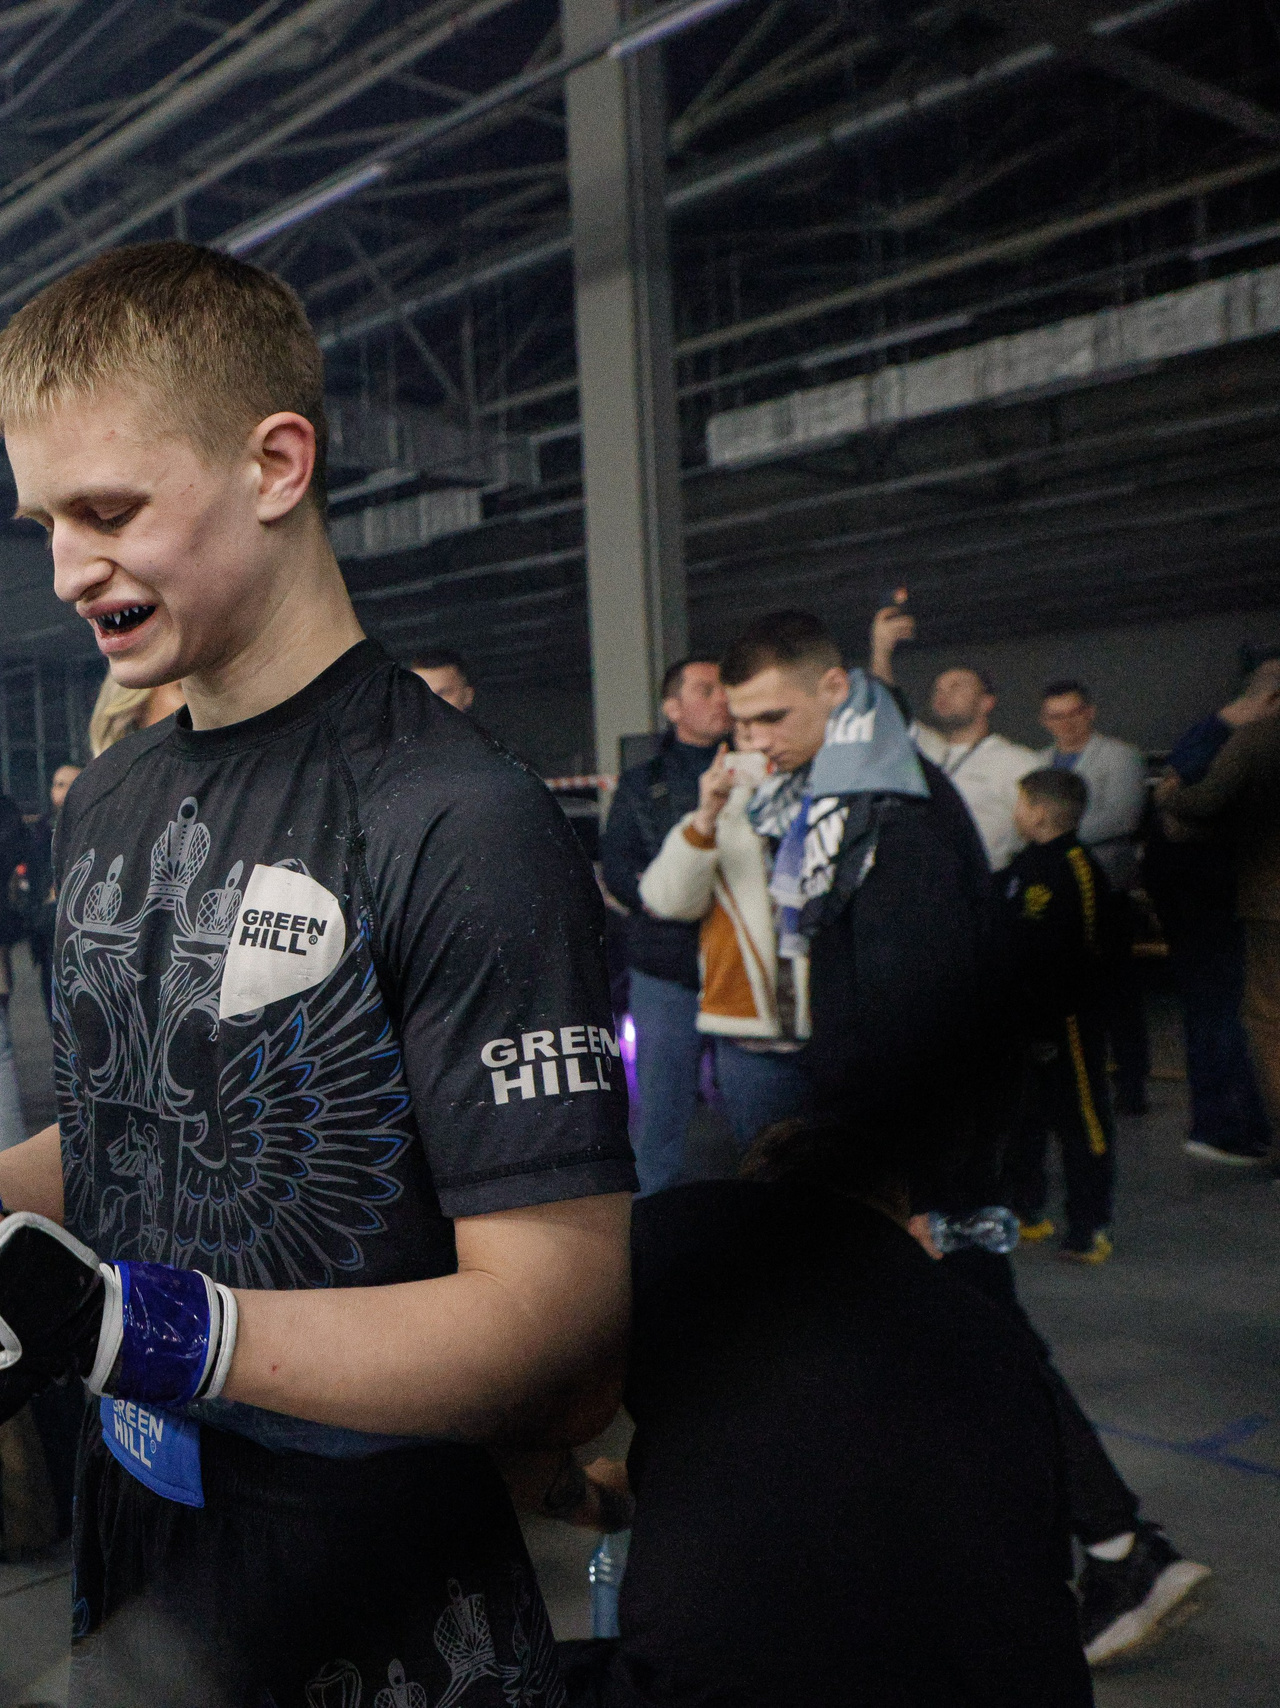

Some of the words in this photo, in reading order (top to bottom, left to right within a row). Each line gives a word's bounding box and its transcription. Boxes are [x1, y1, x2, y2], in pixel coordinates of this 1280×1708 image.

[242, 909, 328, 936] GREEN
[481, 1025, 620, 1068] GREEN
[491, 1056, 611, 1105] HILL
